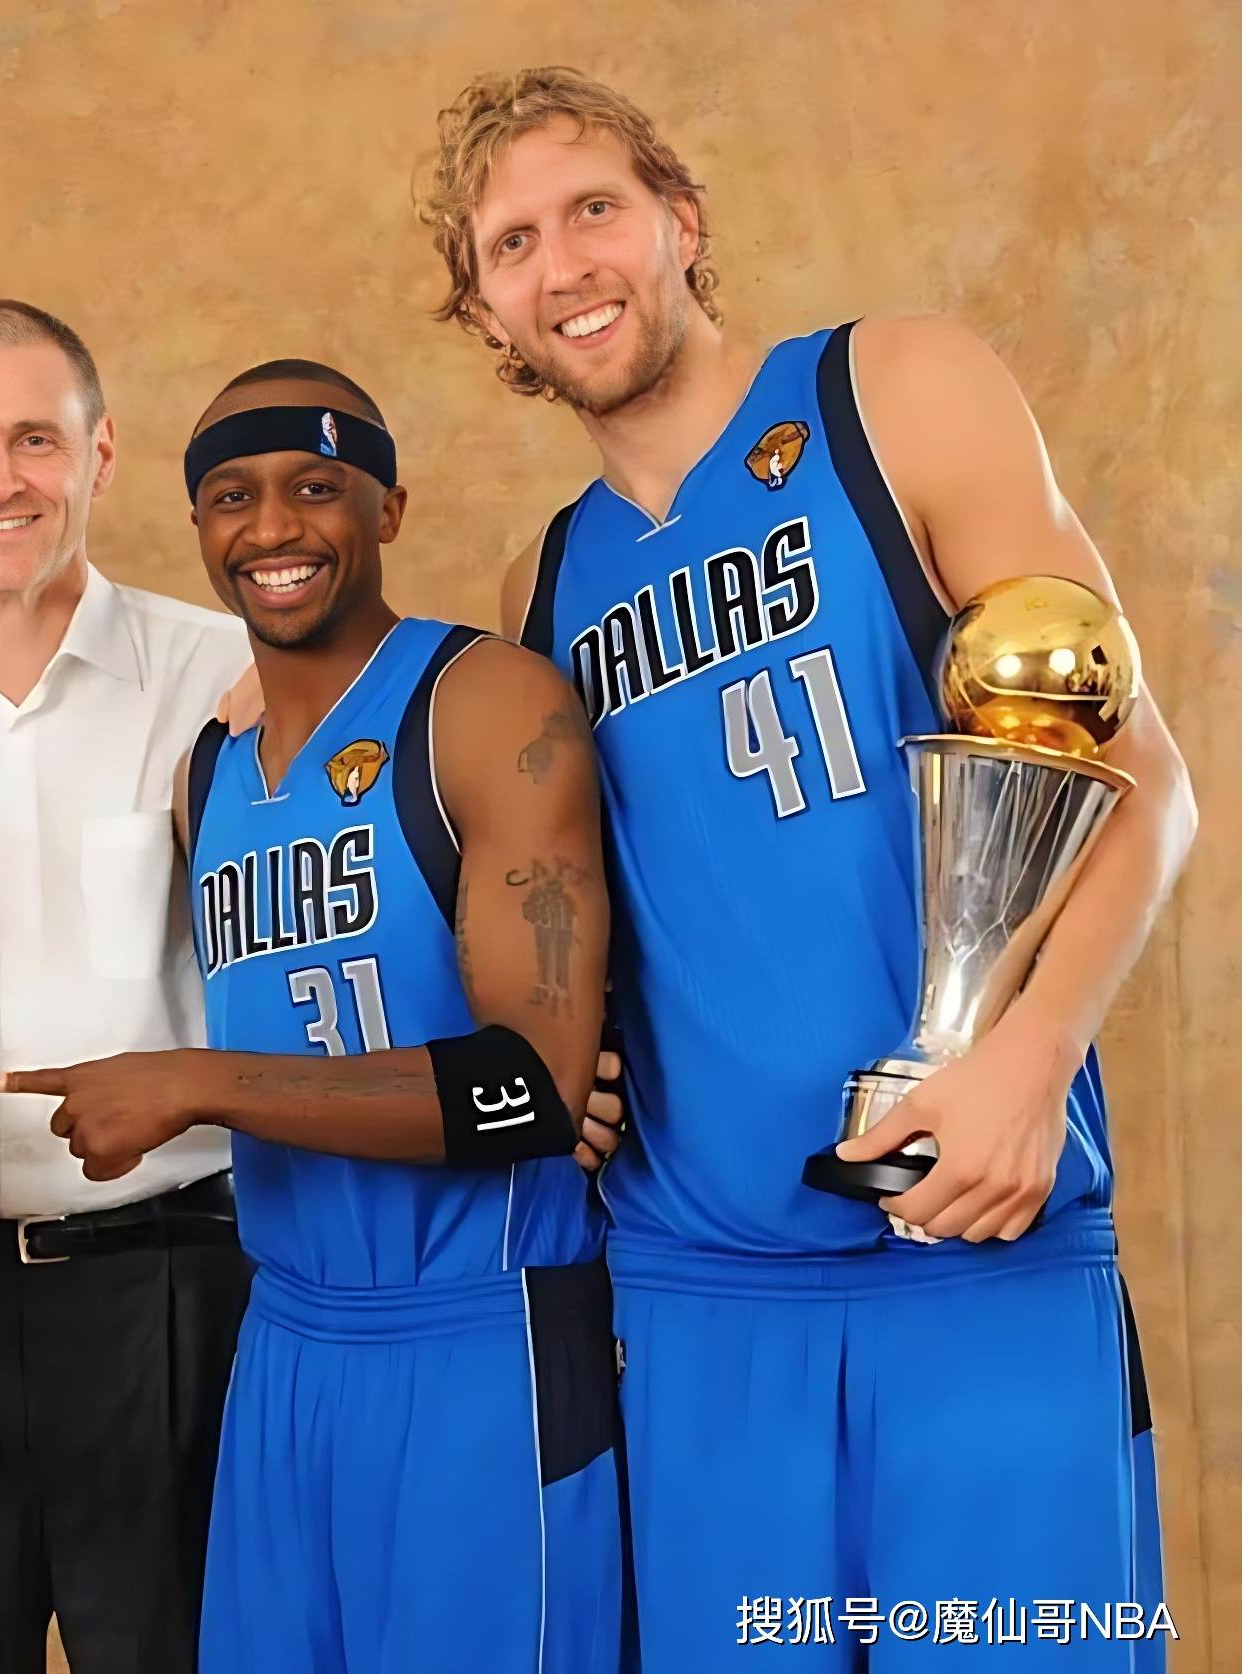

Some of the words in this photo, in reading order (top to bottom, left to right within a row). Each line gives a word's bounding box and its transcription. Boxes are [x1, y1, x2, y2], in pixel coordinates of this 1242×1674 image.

[570, 516, 820, 732] DALLAS
[721, 648, 867, 818] 41
[199, 824, 379, 980] DALLAS
[288, 957, 392, 1057] 31
[472, 1077, 535, 1131] 31
